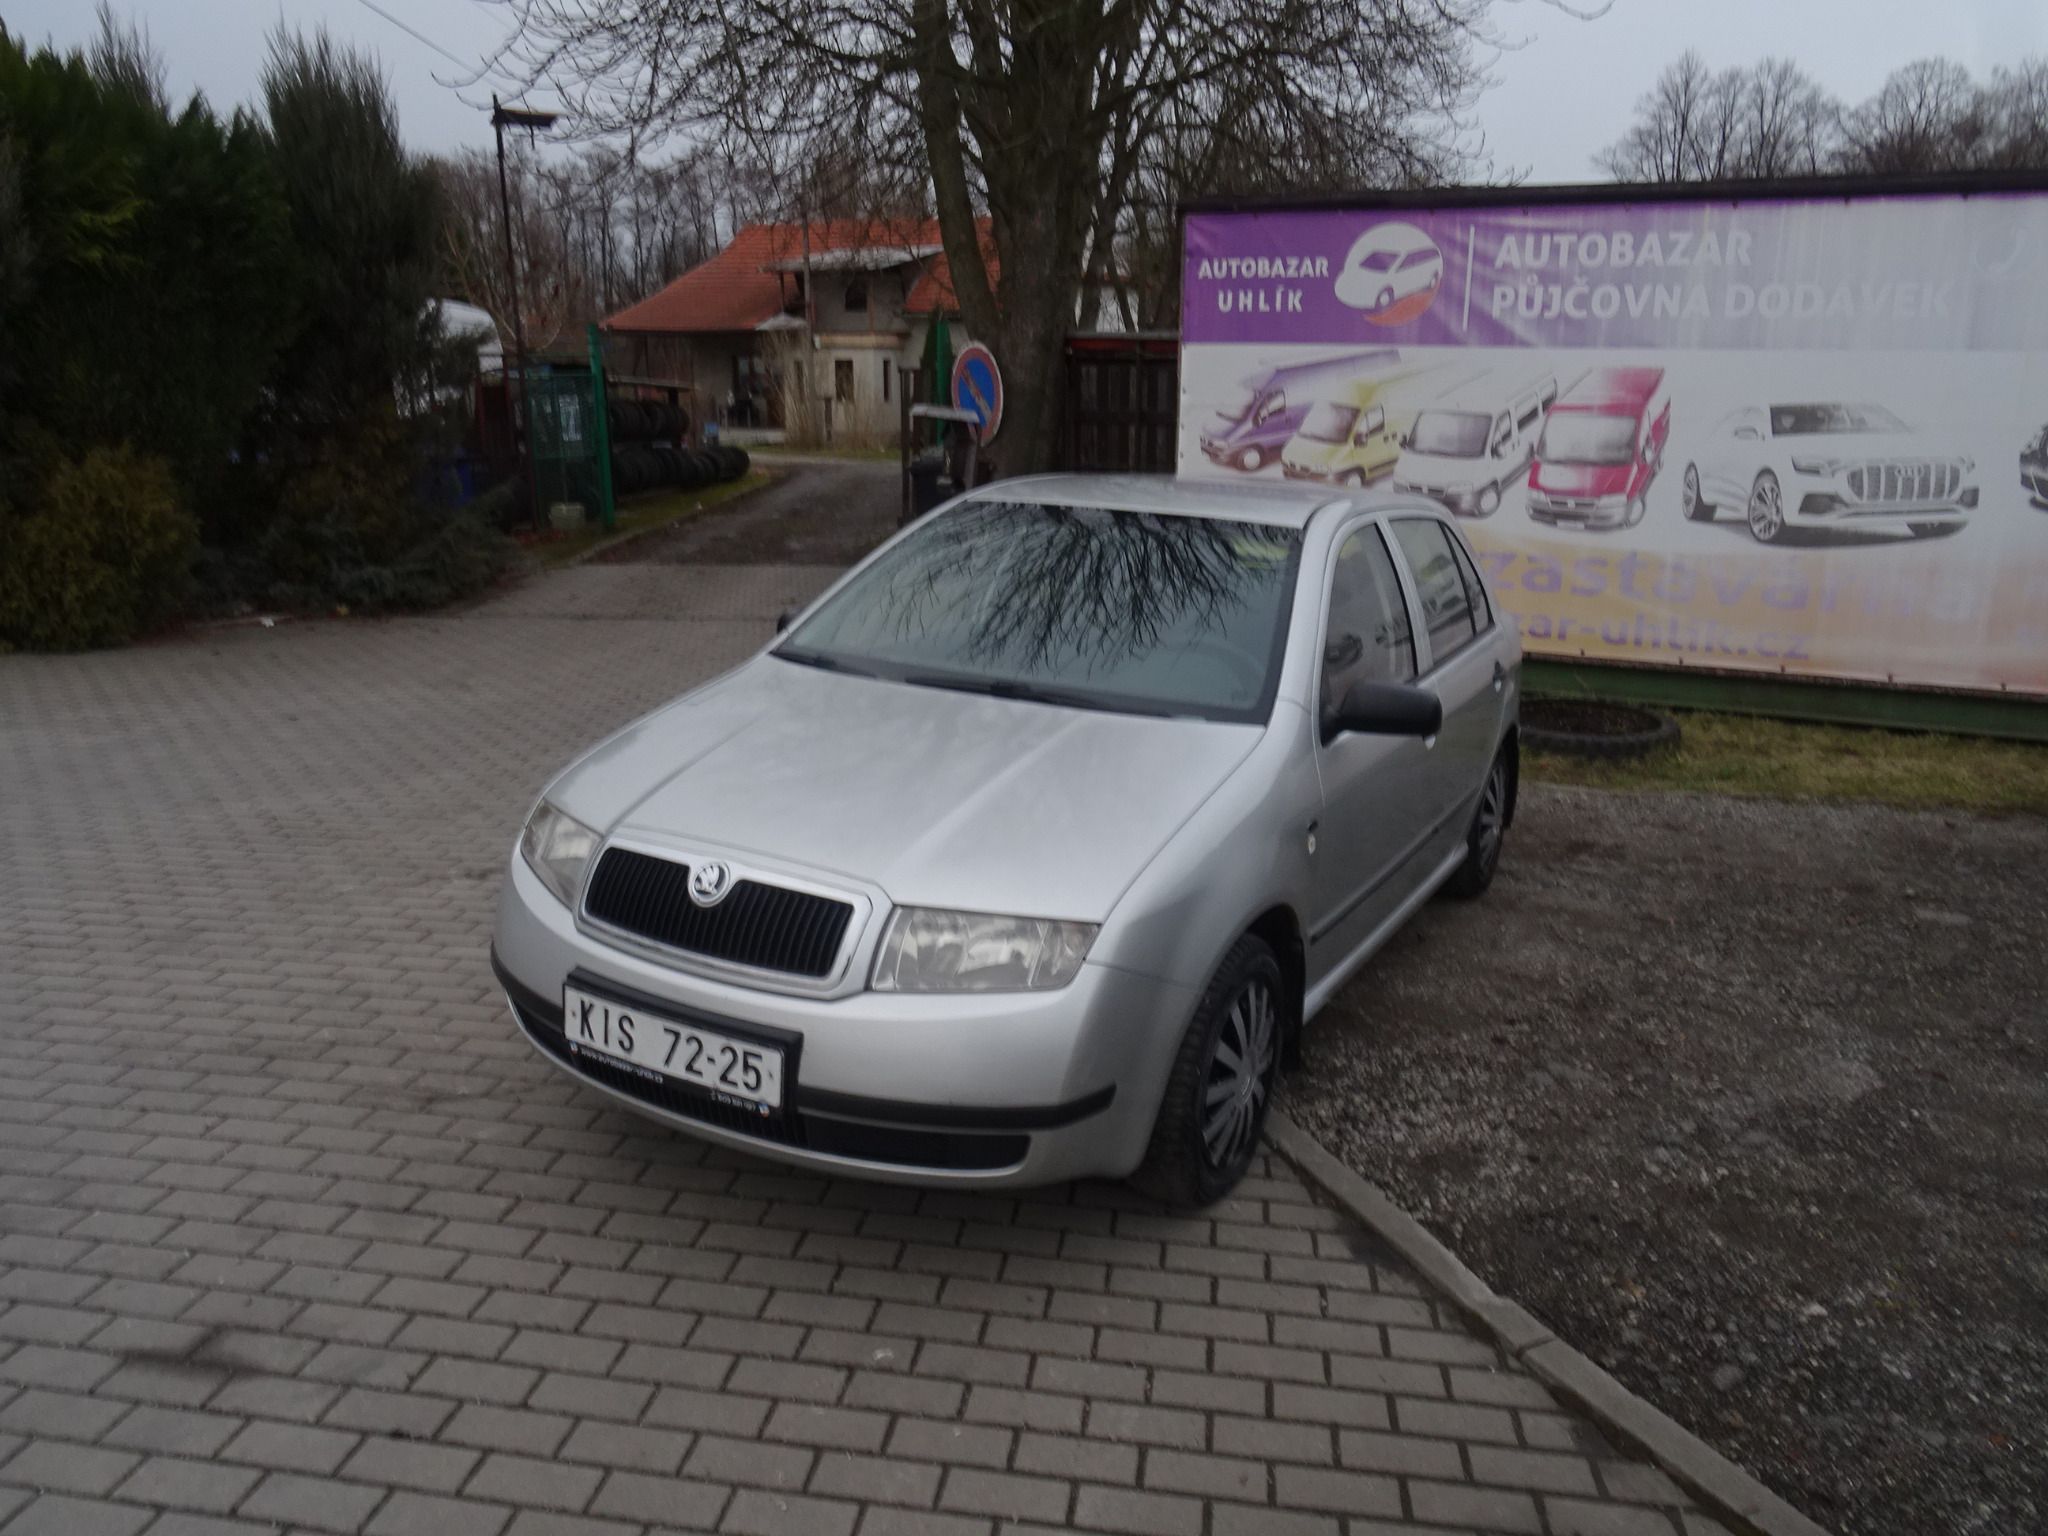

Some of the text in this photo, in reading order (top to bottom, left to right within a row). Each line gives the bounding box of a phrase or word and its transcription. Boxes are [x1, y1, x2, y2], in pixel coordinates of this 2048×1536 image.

[1198, 256, 1329, 280] AUTOBAZAR
[1495, 231, 1751, 269] AUTOBAZAR
[1218, 285, 1303, 313] UHLÍK
[1492, 273, 1711, 320] PŮJČOVNA
[580, 999, 635, 1052] KIS
[663, 1028, 764, 1093] 72-25
